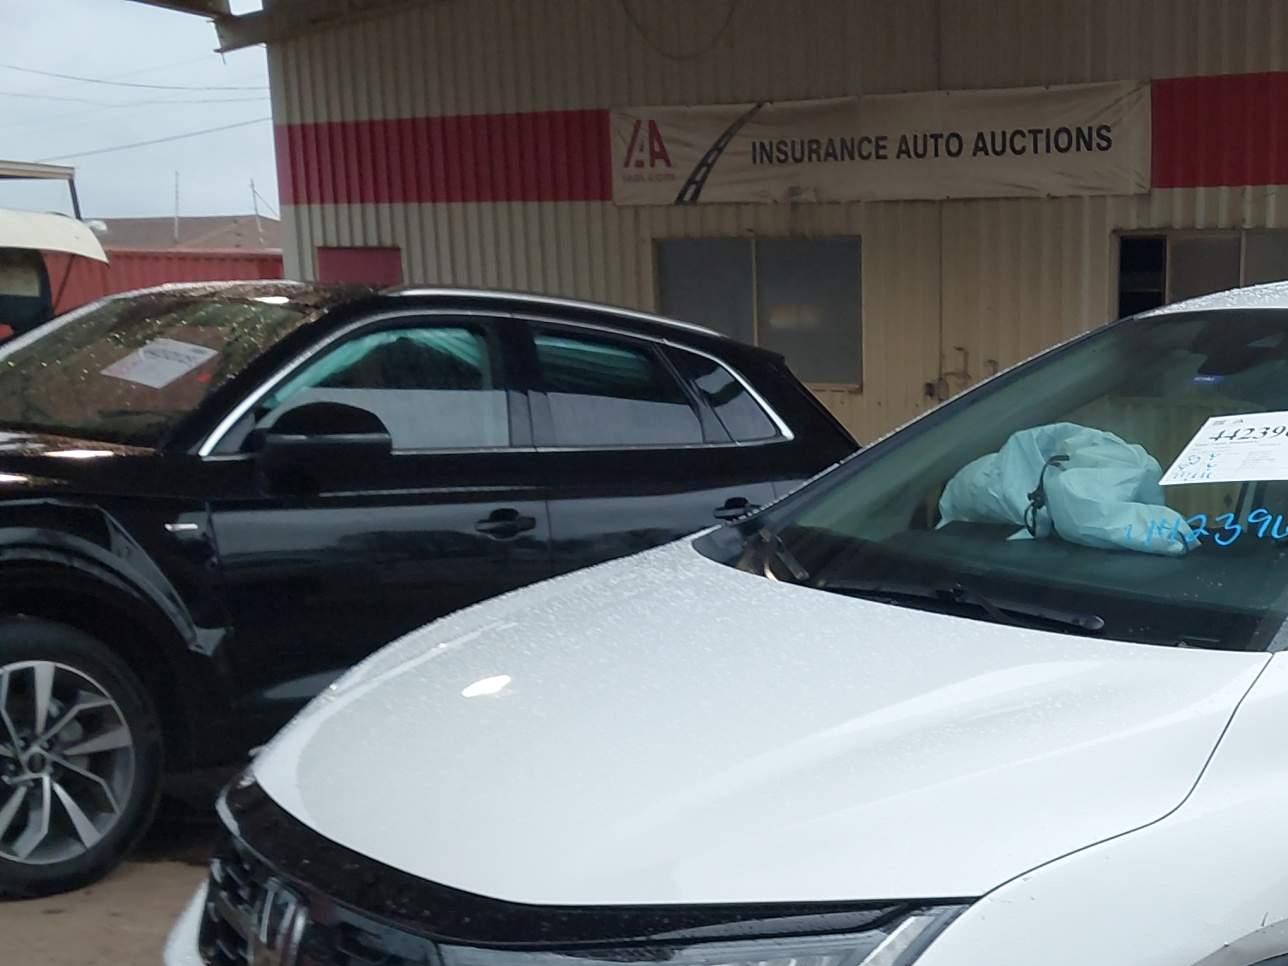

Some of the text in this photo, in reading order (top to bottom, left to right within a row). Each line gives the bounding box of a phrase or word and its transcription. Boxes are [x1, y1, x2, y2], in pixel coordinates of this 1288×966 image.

[751, 124, 1113, 165] INSURANCE AUTO AUCTIONS
